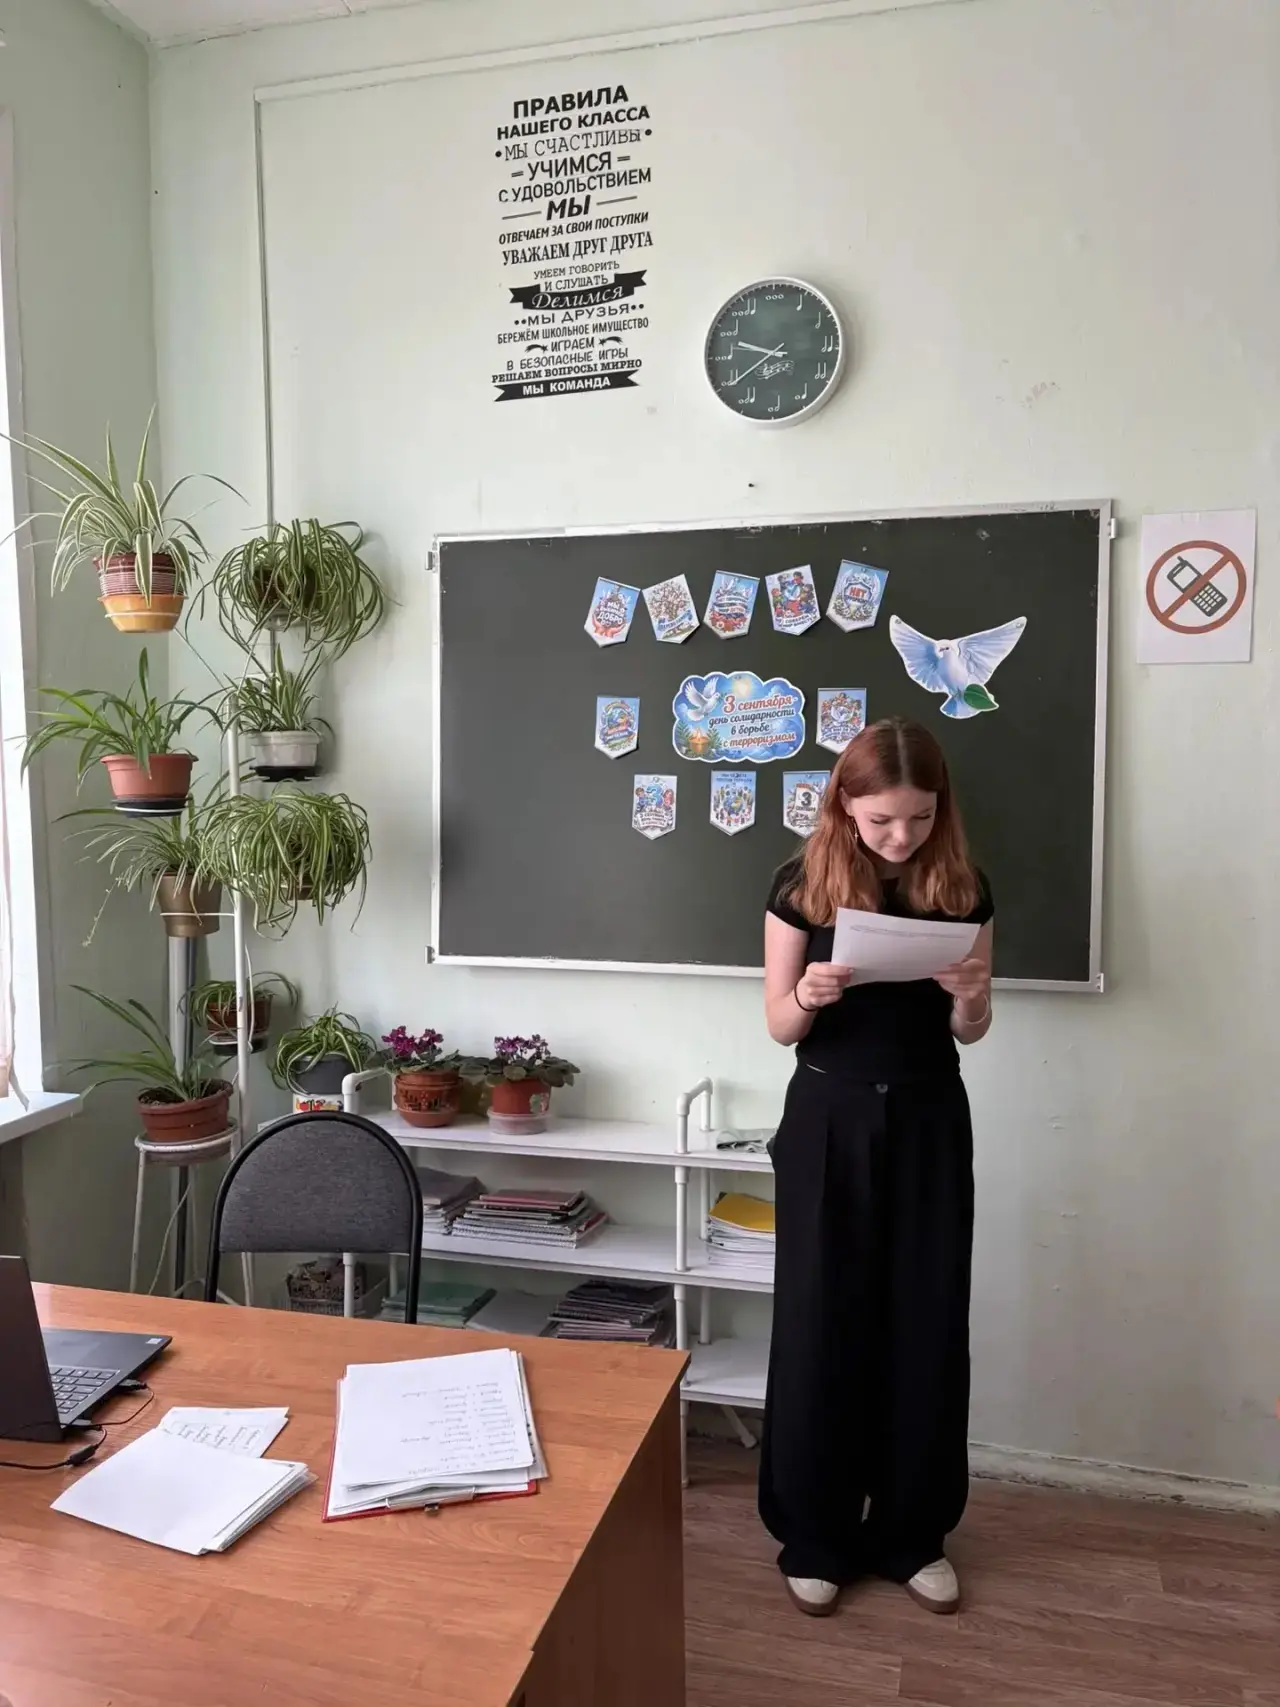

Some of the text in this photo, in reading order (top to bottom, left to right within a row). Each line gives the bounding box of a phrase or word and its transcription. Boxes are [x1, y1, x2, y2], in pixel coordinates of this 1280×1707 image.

[513, 85, 629, 119] ПРАВИЛА
[497, 105, 650, 140] НАШЕГО КЛАССА
[505, 129, 641, 161] МЫ СЧАСТЛИВЫ
[527, 151, 612, 181] УЧИМСЯ
[498, 167, 652, 203] С УДОВОЛЬСТВИЕМ
[546, 194, 591, 221] МЫ
[498, 211, 649, 245] ОТВЕЧАЕМ ЗА СВОИ ПОСТУПКИ
[502, 231, 654, 266] УВАЖАЕМ ДРУГ ДРУГА
[534, 260, 620, 280] УМЕЕМ ГОВОРИТЬ
[544, 274, 609, 292] И СЛУШАТЬ
[531, 286, 624, 308] Делимся
[527, 303, 629, 326] МЫ ДРУЗЬЯ
[497, 317, 649, 344] БЕРЕЖЁМ ШКОЛЬНОЕ ИМУЩЕСТВО
[551, 337, 595, 352] ИГРАЕМ
[491, 359, 642, 383] РЕШАЕМ ВОПРОСЫ МИРНО
[506, 348, 628, 371] В БЕЗОПАСНЫЕ ИГРЫ
[522, 376, 611, 396] МЫ КОМАНДА
[723, 695, 793, 714] 3 сентября
[708, 709, 795, 728] день солидарности
[731, 723, 770, 736] в борьбе
[729, 732, 795, 748] терроризмом
[801, 792, 812, 807] 3
